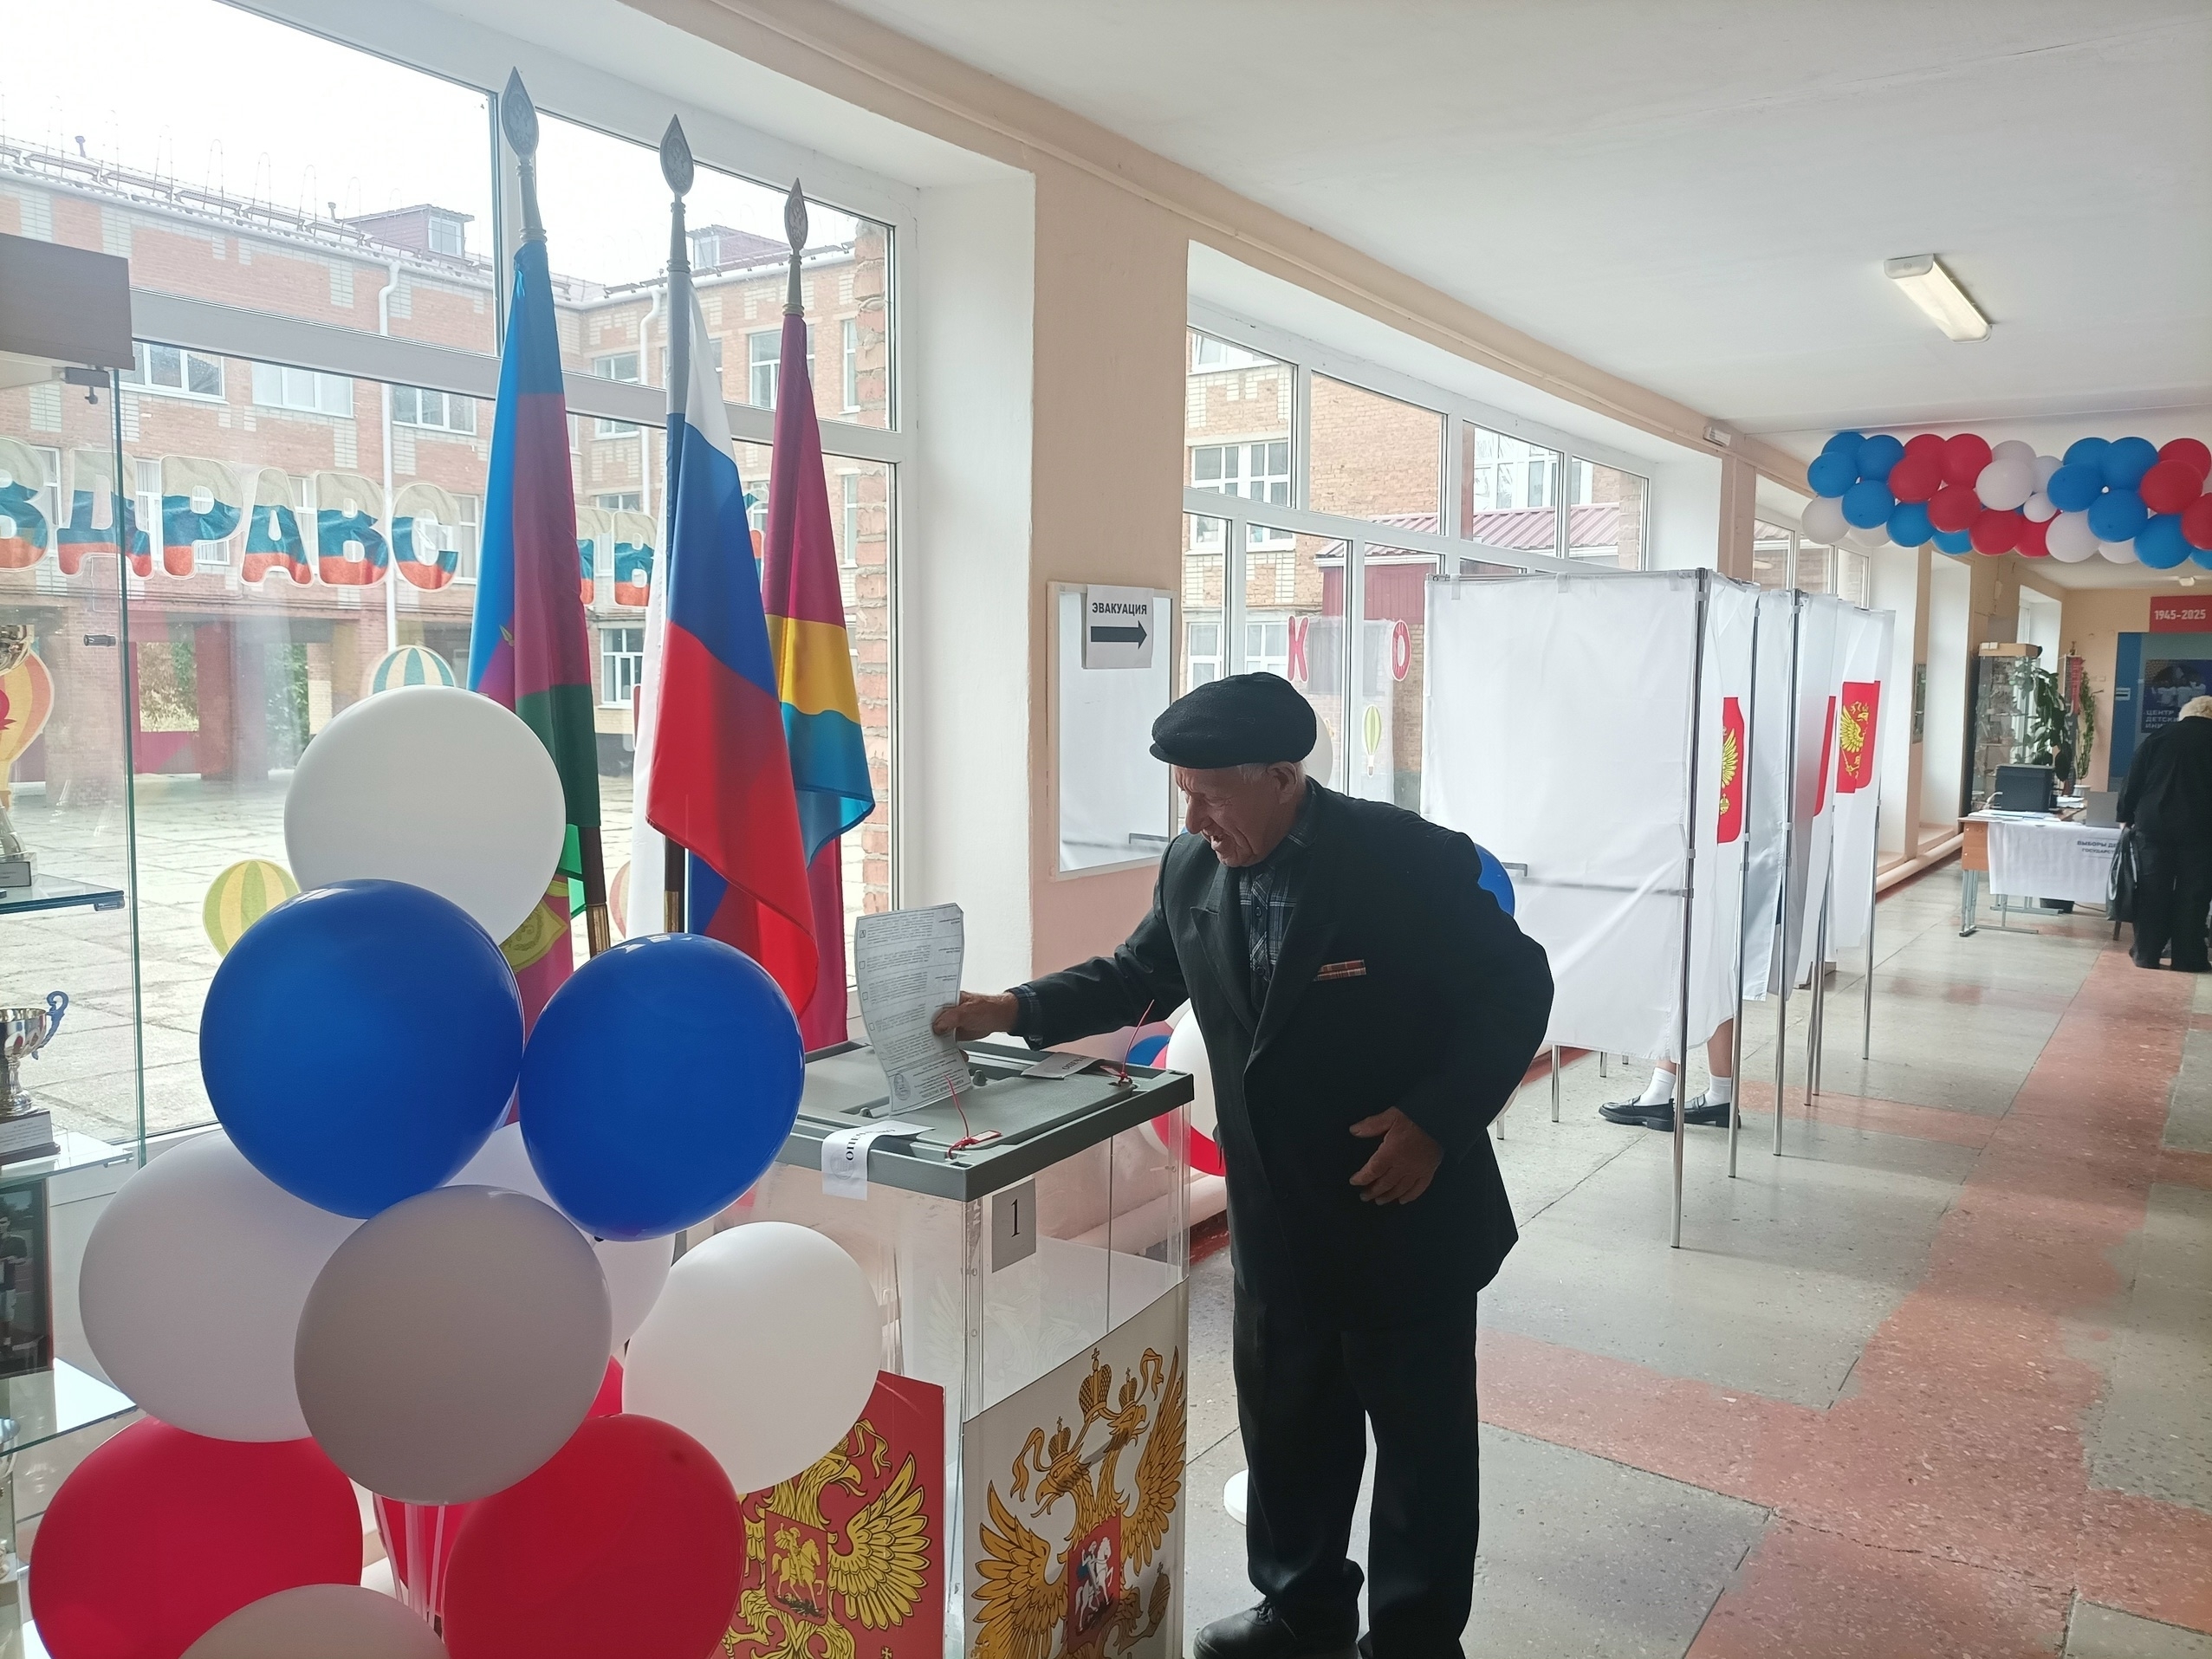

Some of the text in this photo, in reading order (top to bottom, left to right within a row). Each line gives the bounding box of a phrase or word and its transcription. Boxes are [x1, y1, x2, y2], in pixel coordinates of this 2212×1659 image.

[1092, 602, 1148, 616] ЭВАКУАЦИЯ
[2154, 609, 2206, 620] 1945-2025
[1011, 1198, 1021, 1237] 1
